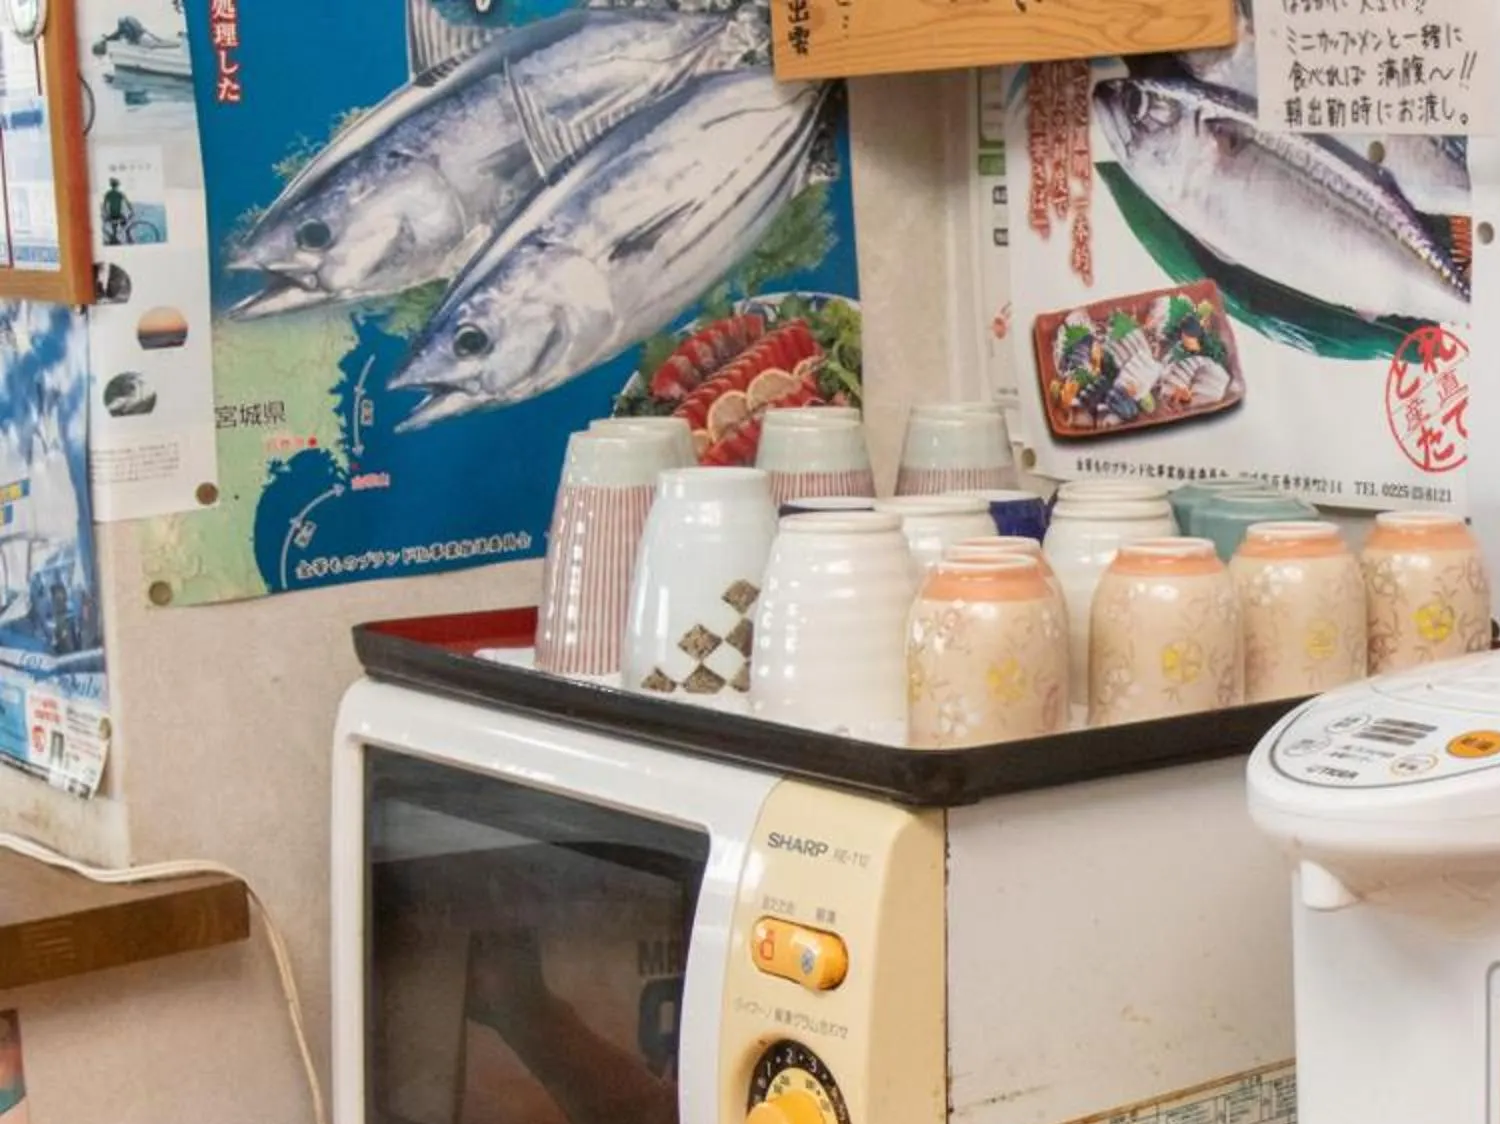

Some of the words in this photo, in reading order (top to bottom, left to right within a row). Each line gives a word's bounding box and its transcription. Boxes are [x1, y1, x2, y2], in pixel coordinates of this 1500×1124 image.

[214, 400, 286, 429] 宮城県
[767, 831, 829, 858] SHARP
[785, 1047, 794, 1064] 2
